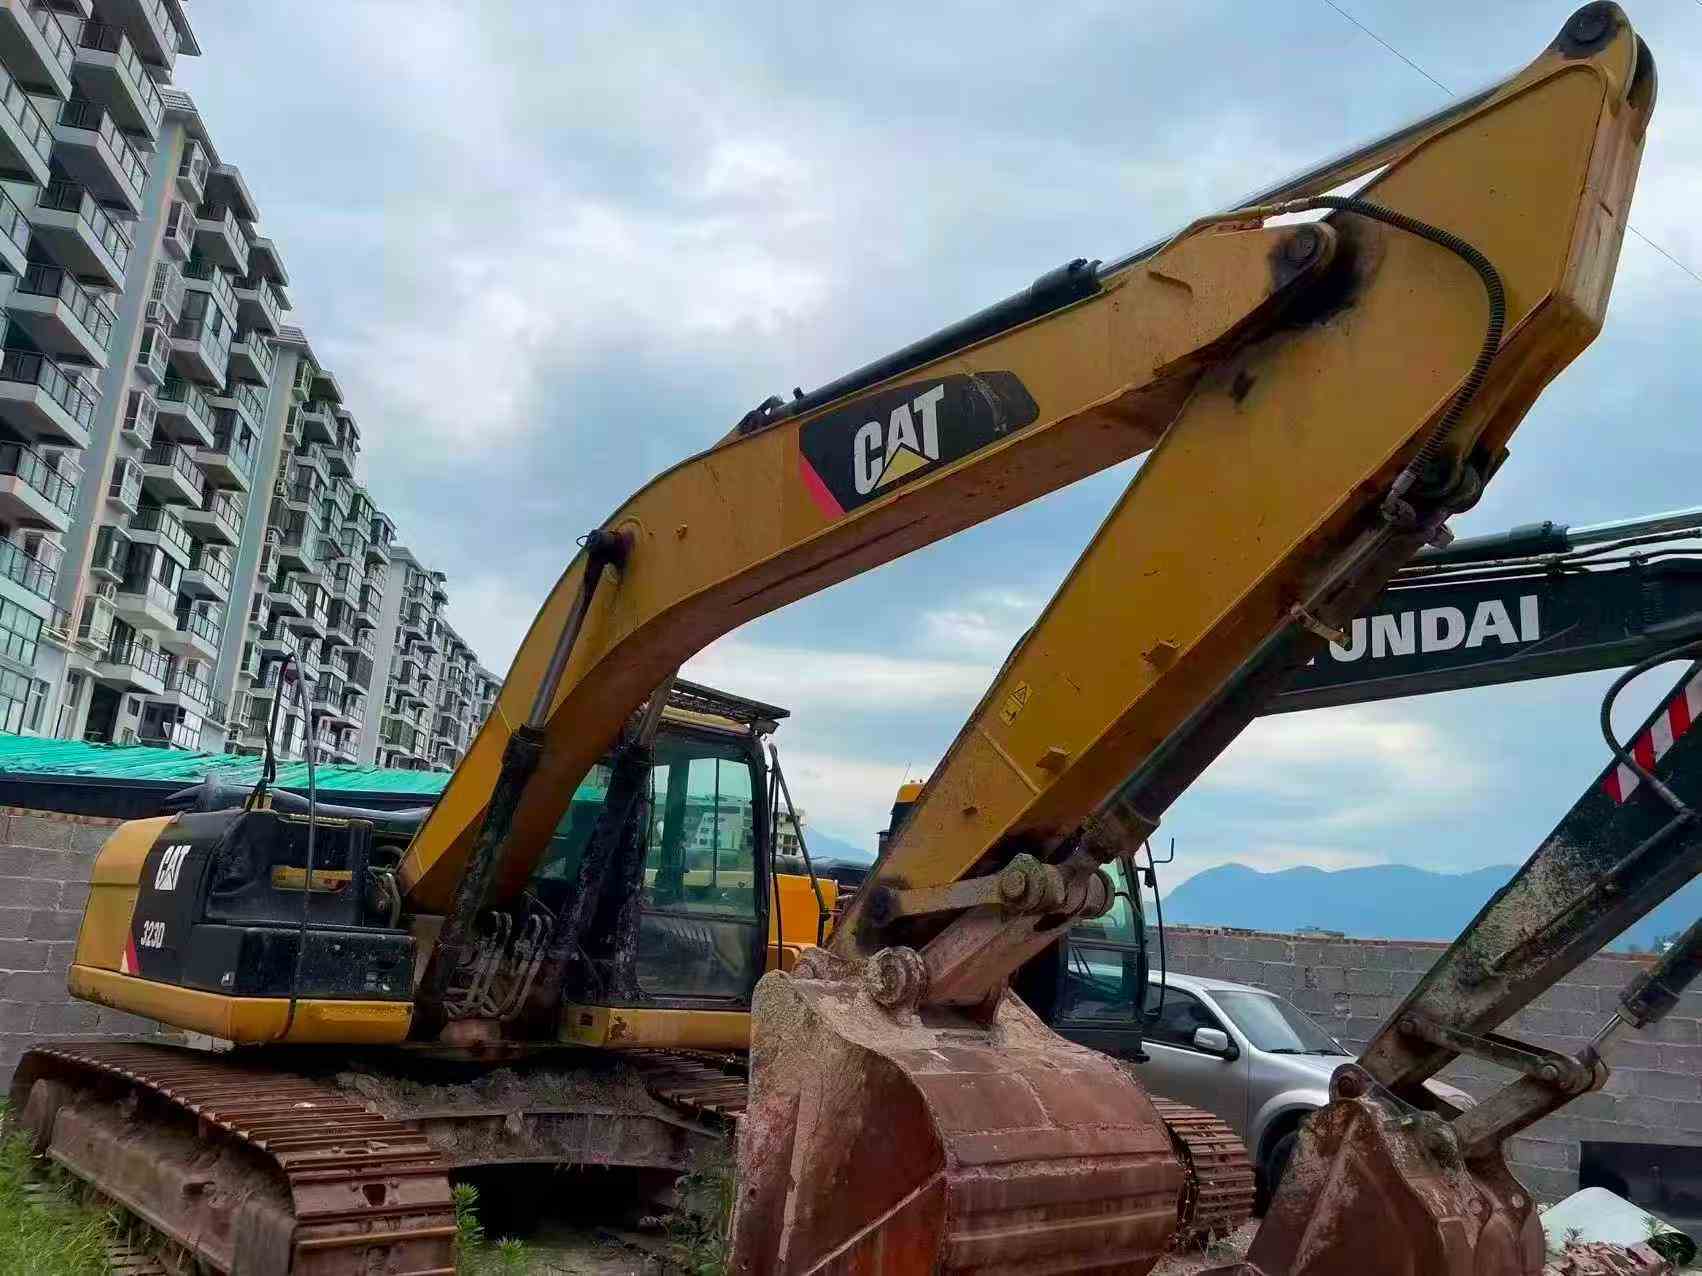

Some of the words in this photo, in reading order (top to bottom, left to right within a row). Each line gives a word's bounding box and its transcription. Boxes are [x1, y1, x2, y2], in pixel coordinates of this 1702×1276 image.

[854, 384, 944, 495] CAT
[1306, 595, 1540, 666] UNDAI
[154, 845, 192, 891] CAT
[141, 920, 165, 948] 323D
